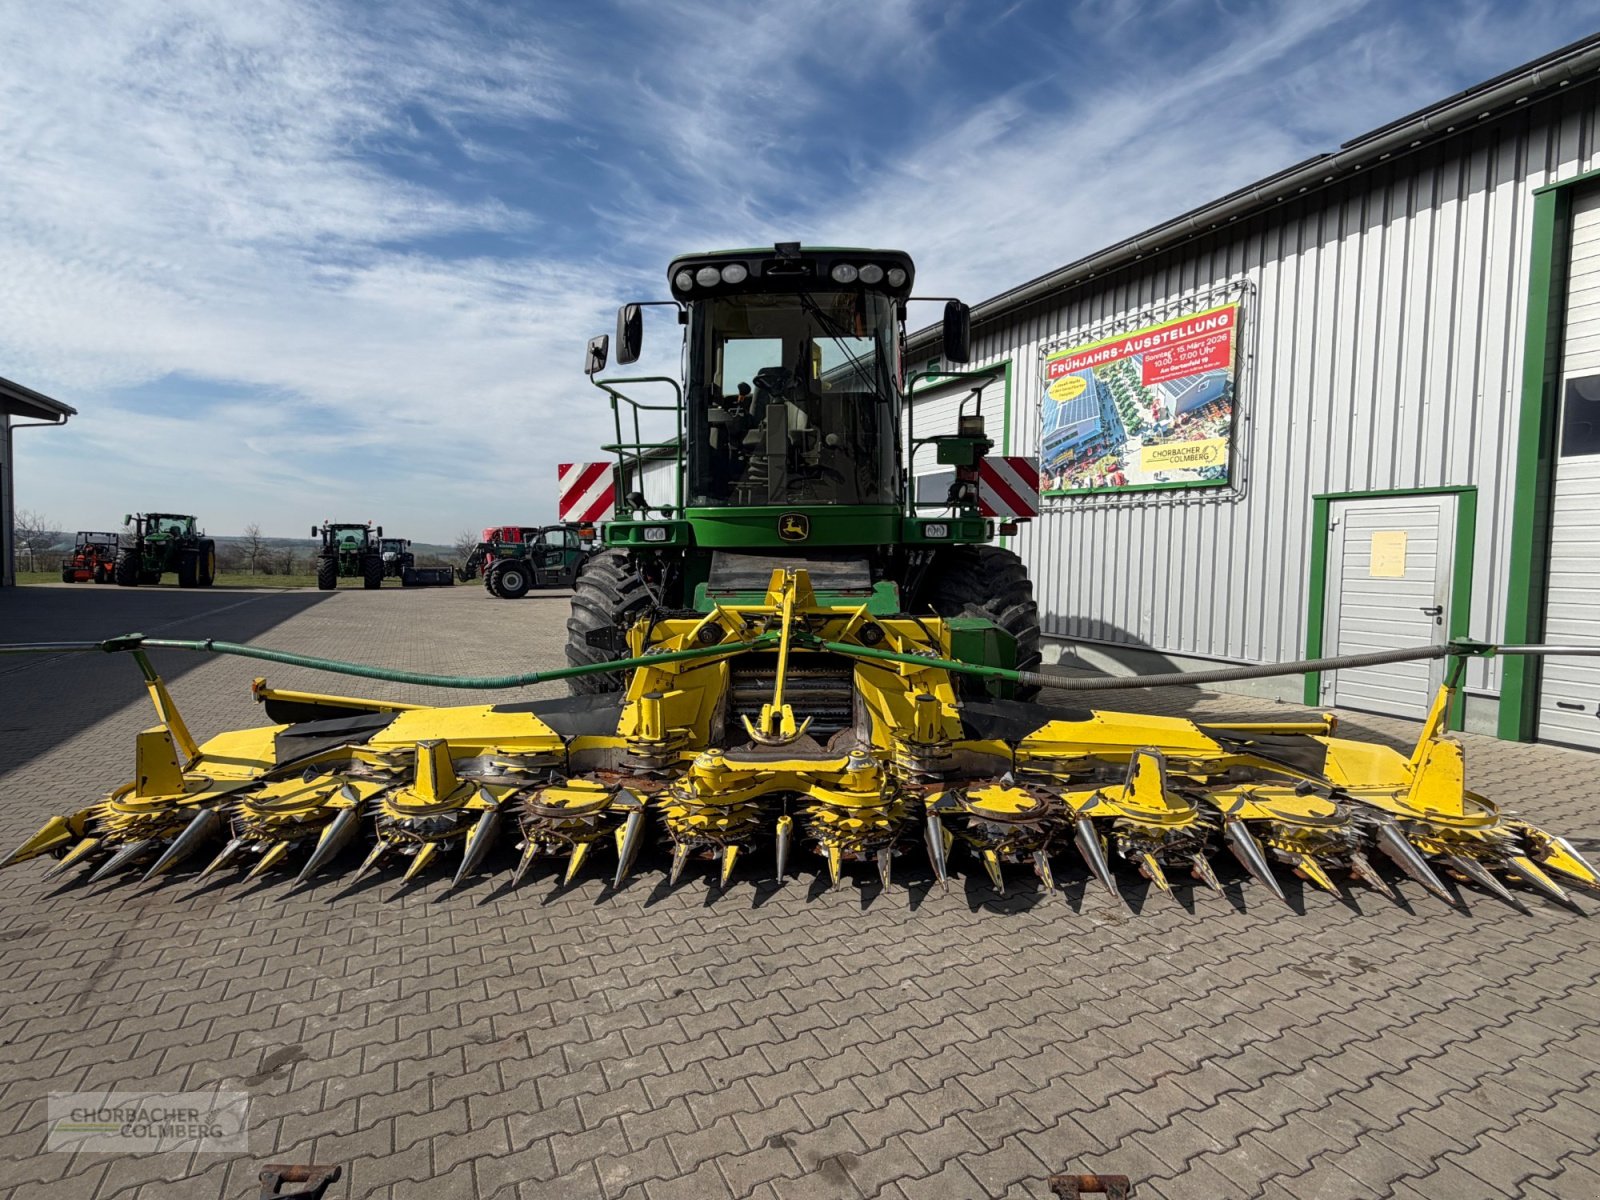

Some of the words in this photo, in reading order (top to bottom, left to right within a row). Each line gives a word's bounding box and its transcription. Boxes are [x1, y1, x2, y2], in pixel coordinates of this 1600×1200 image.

[1050, 314, 1229, 376] FRÜHJAHRS-AUSSTELLUNG
[1187, 341, 1205, 350] März
[1206, 334, 1228, 345] 2026
[1154, 358, 1173, 367] 10.00
[1179, 351, 1198, 360] 17.00
[1199, 346, 1217, 355] Uhr
[1152, 446, 1200, 458] CHORBACHER
[1169, 453, 1209, 463] COLMBERG
